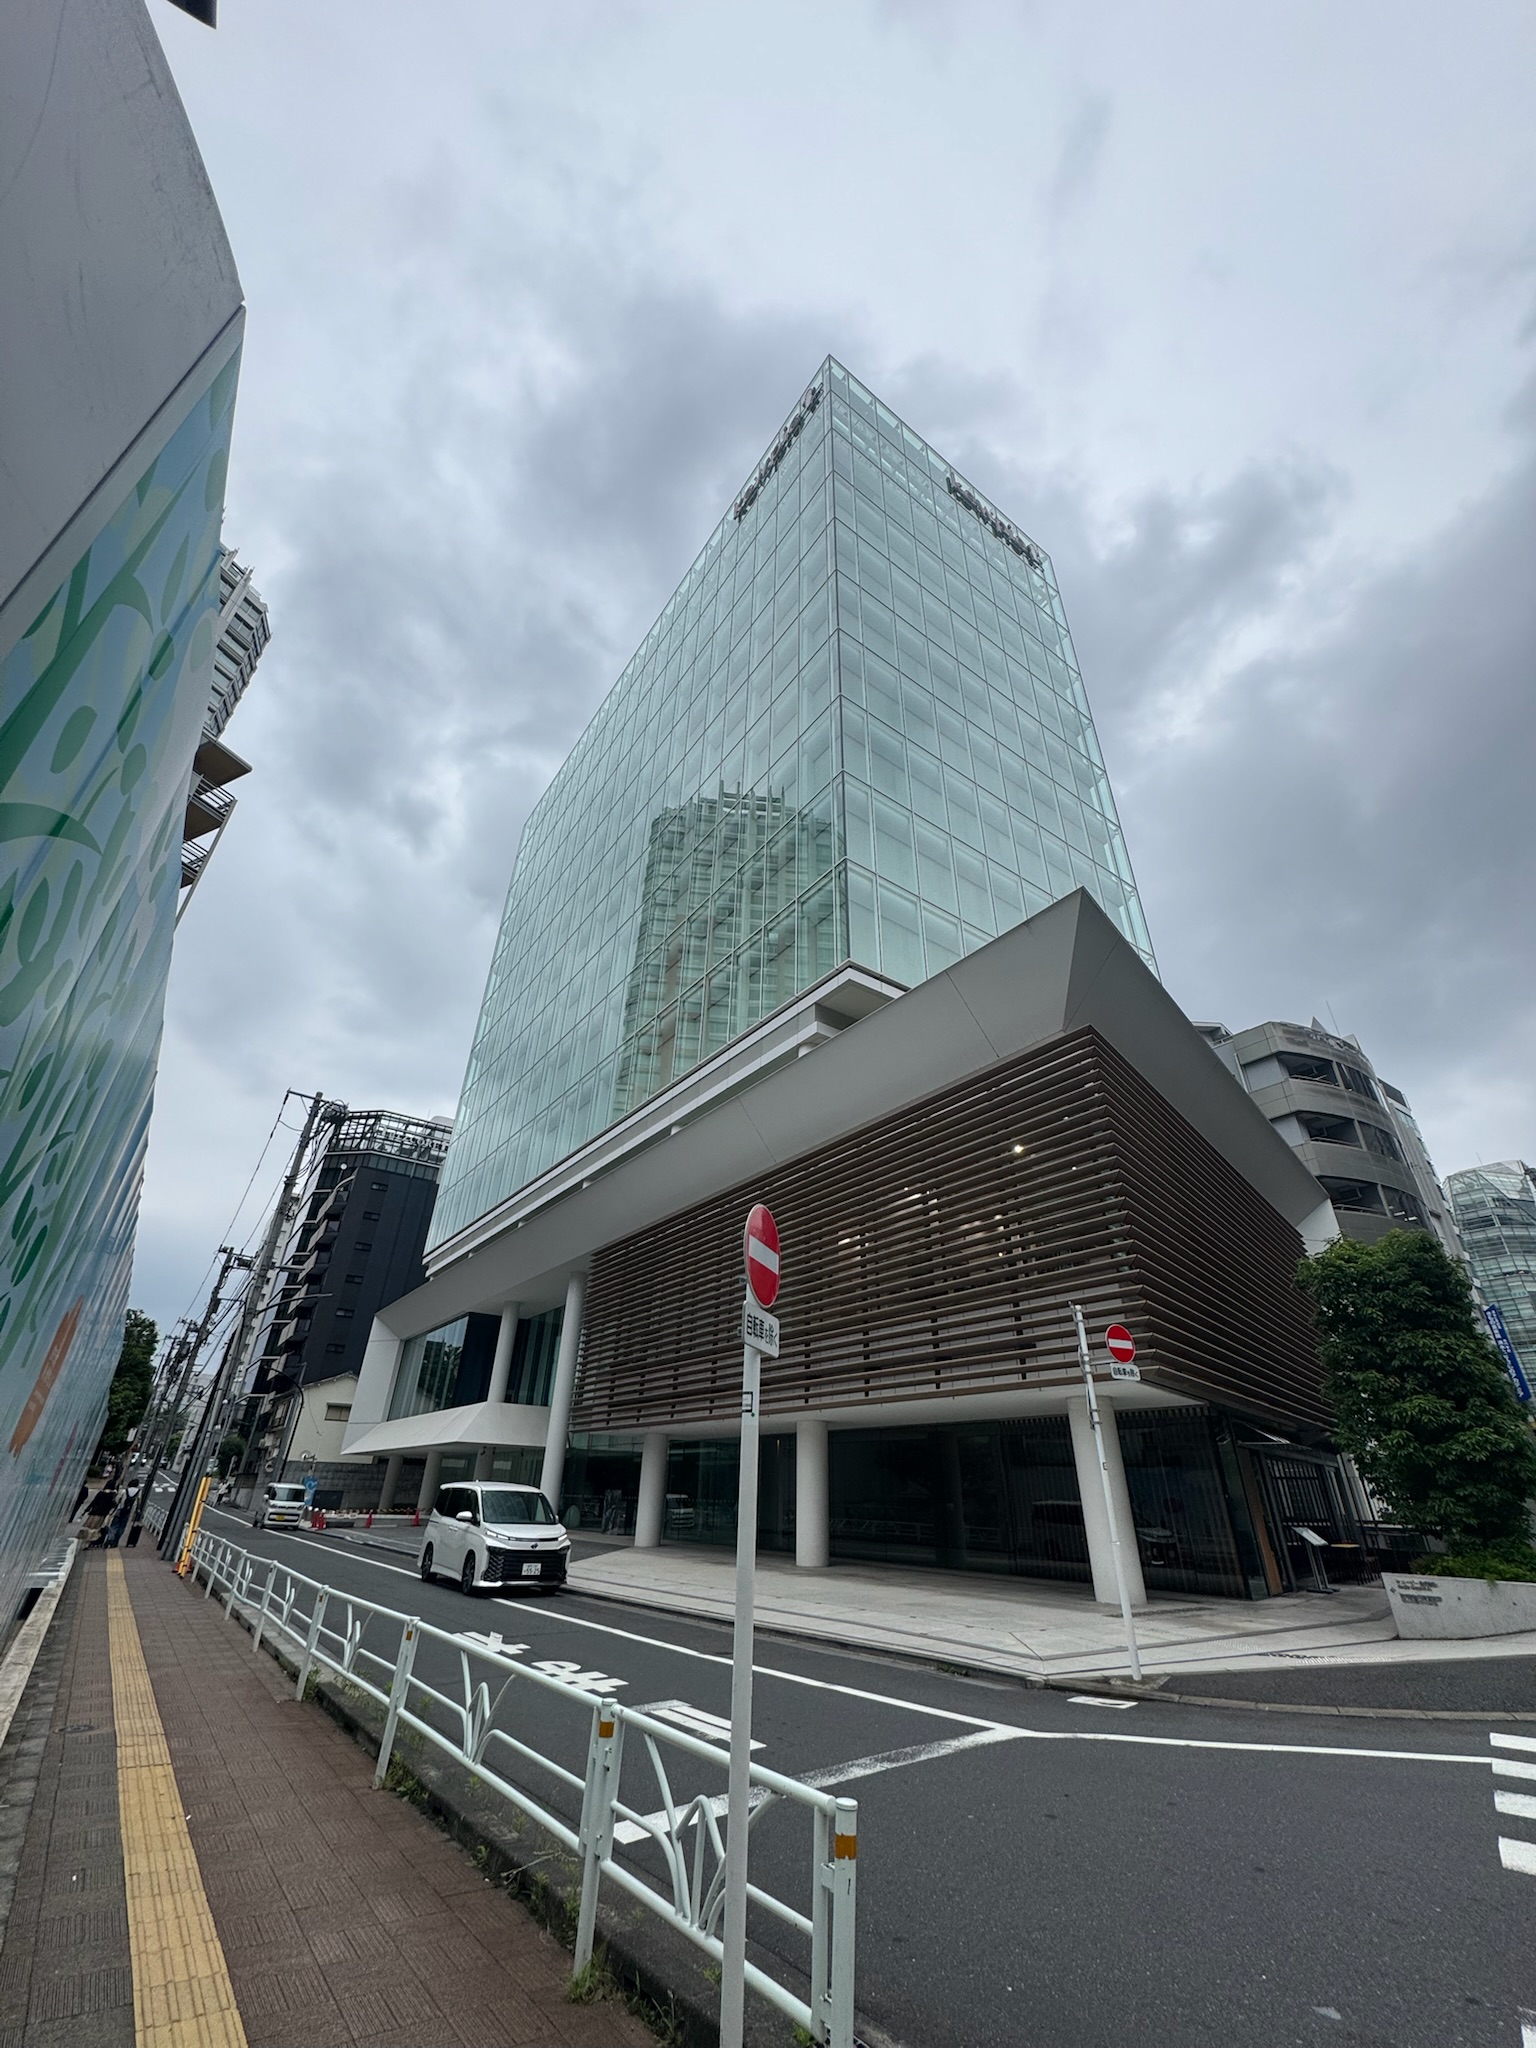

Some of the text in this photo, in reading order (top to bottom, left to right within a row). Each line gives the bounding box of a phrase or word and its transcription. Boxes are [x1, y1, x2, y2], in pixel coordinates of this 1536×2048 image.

[746, 1312, 778, 1348] 自転車を除く
[1112, 1366, 1139, 1378] 自転車を除く
